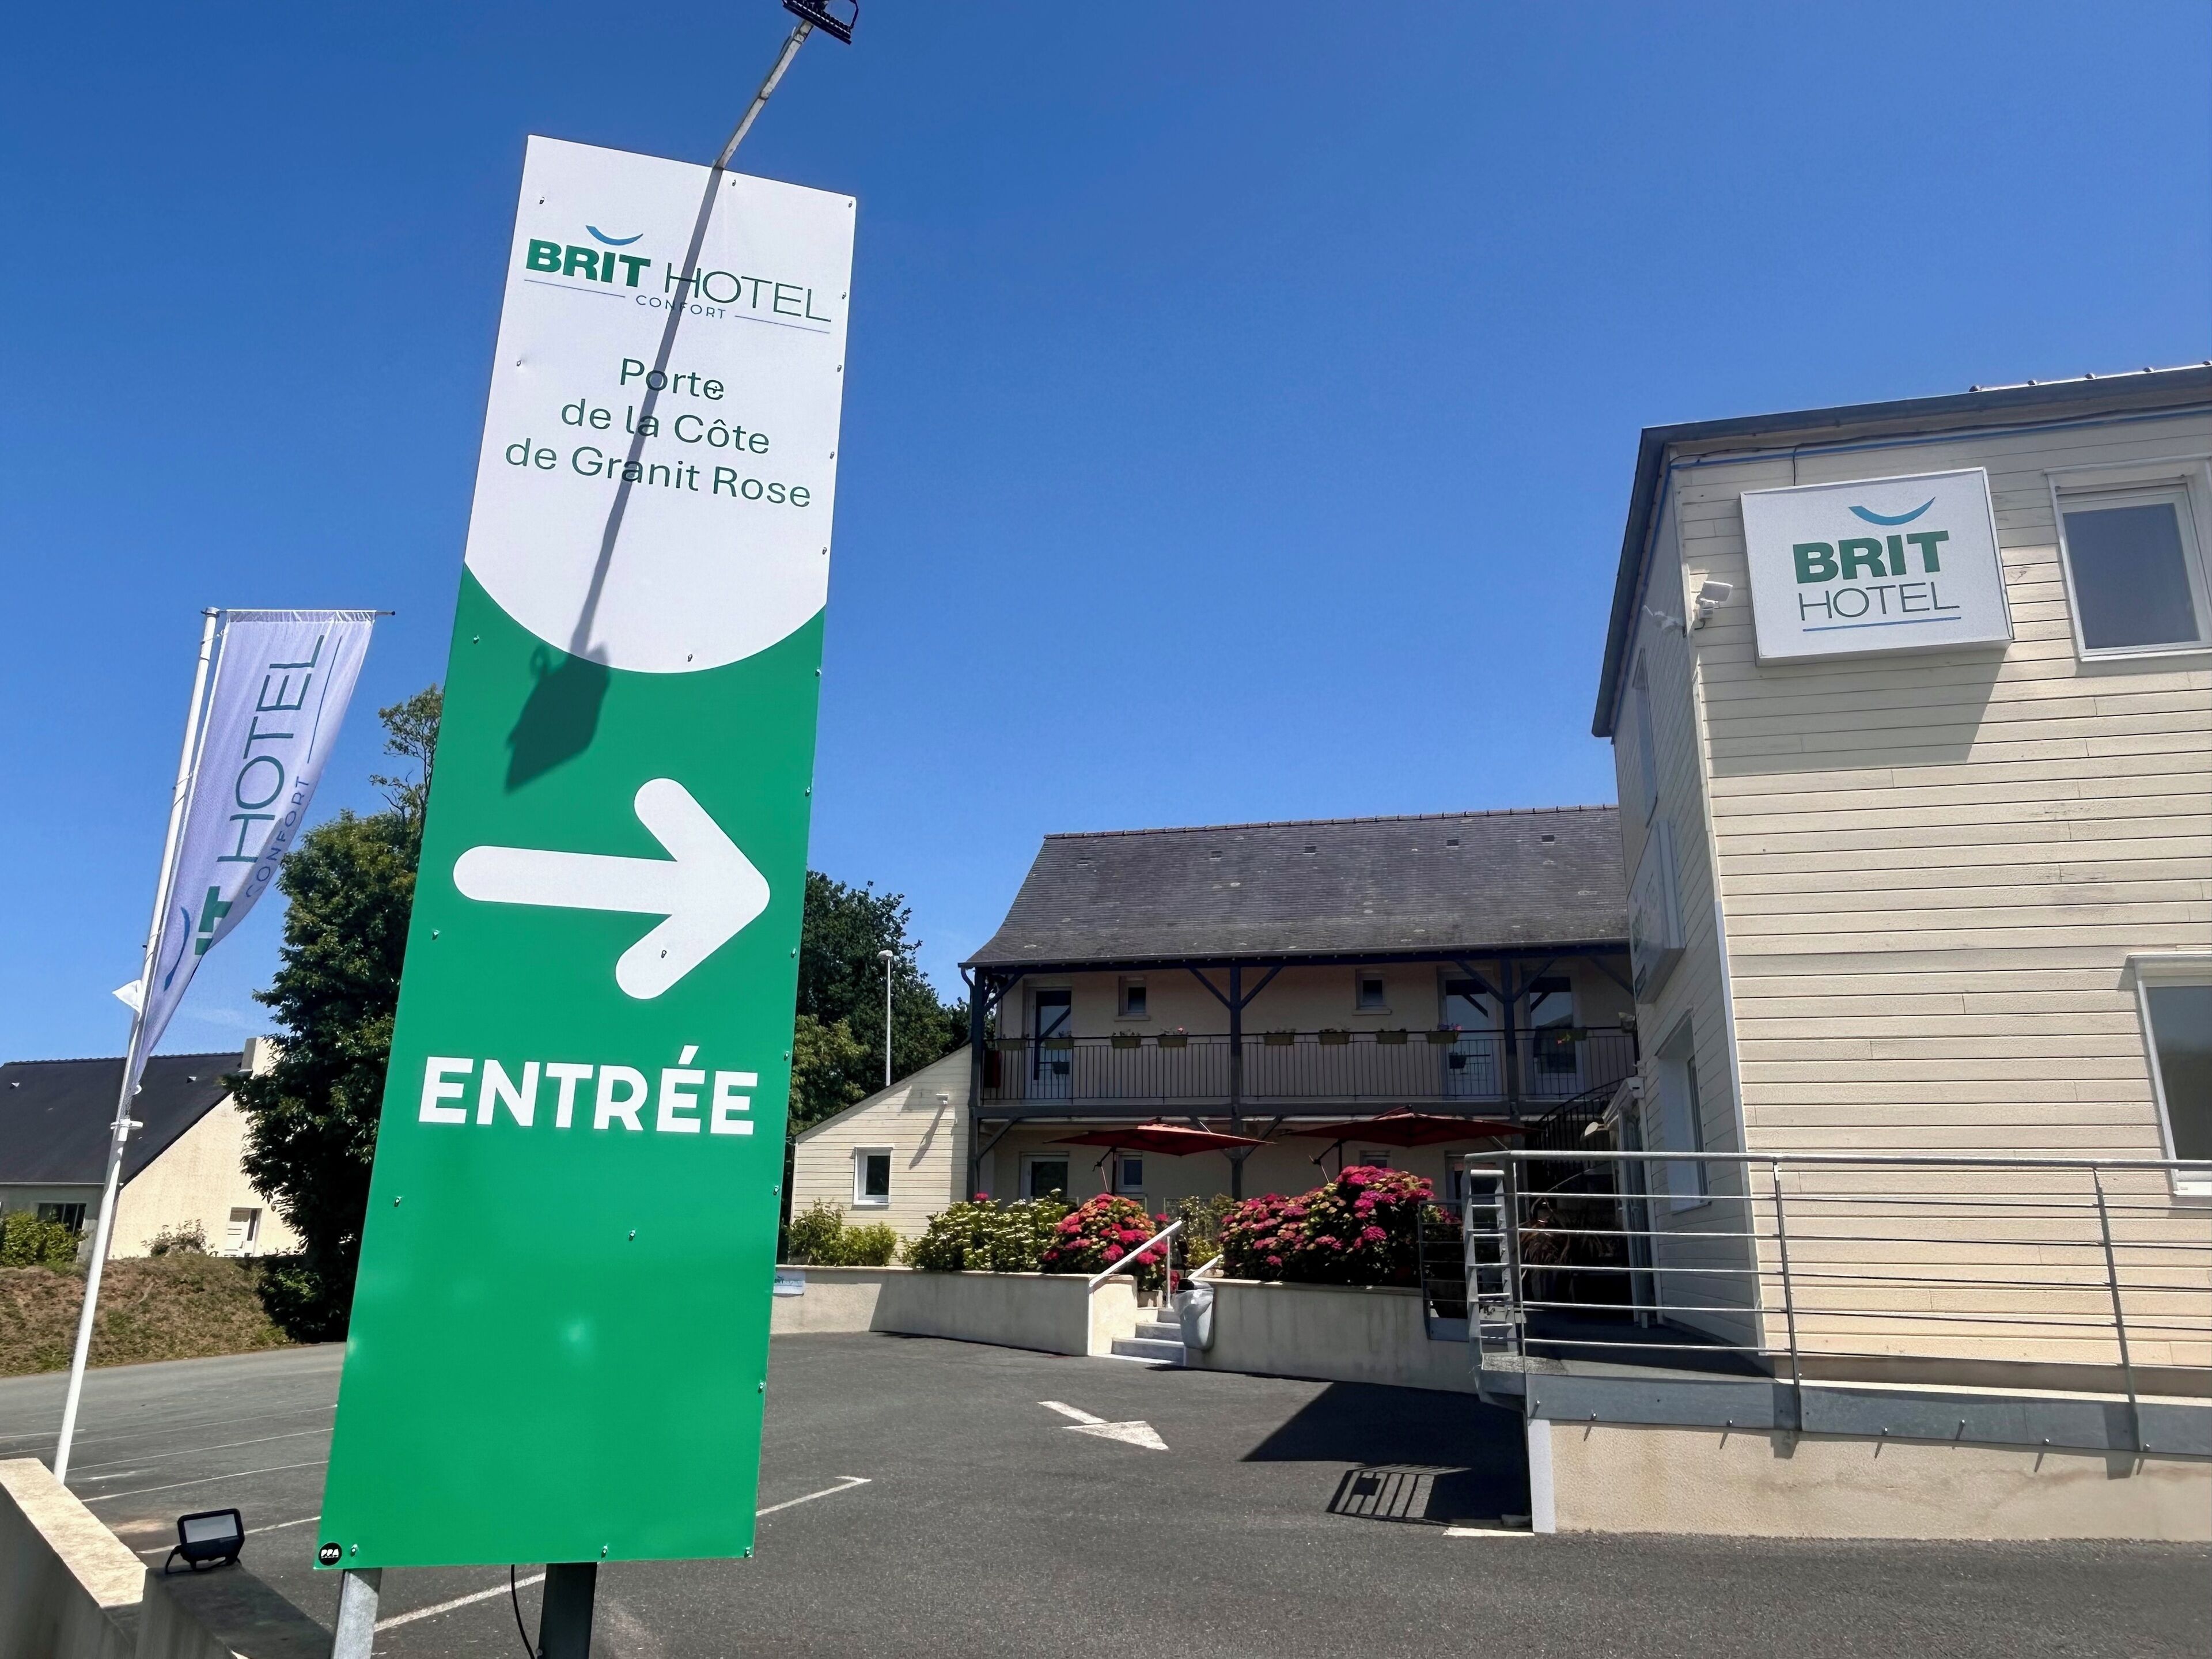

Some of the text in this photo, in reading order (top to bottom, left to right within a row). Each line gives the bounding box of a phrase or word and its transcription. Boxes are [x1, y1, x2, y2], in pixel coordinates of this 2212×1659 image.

[526, 238, 832, 323] BRIT HOTEL
[636, 294, 726, 320] CONFORT
[620, 358, 725, 401] Porte
[561, 398, 770, 454] de la Côte
[505, 438, 811, 507] de Granit Rose
[1792, 530, 1950, 584] BRIT
[1798, 581, 1960, 621] HOTEL
[217, 635, 324, 863] HOTEL
[246, 777, 310, 897] CONFORT
[418, 1045, 759, 1135] ENTRÉE
